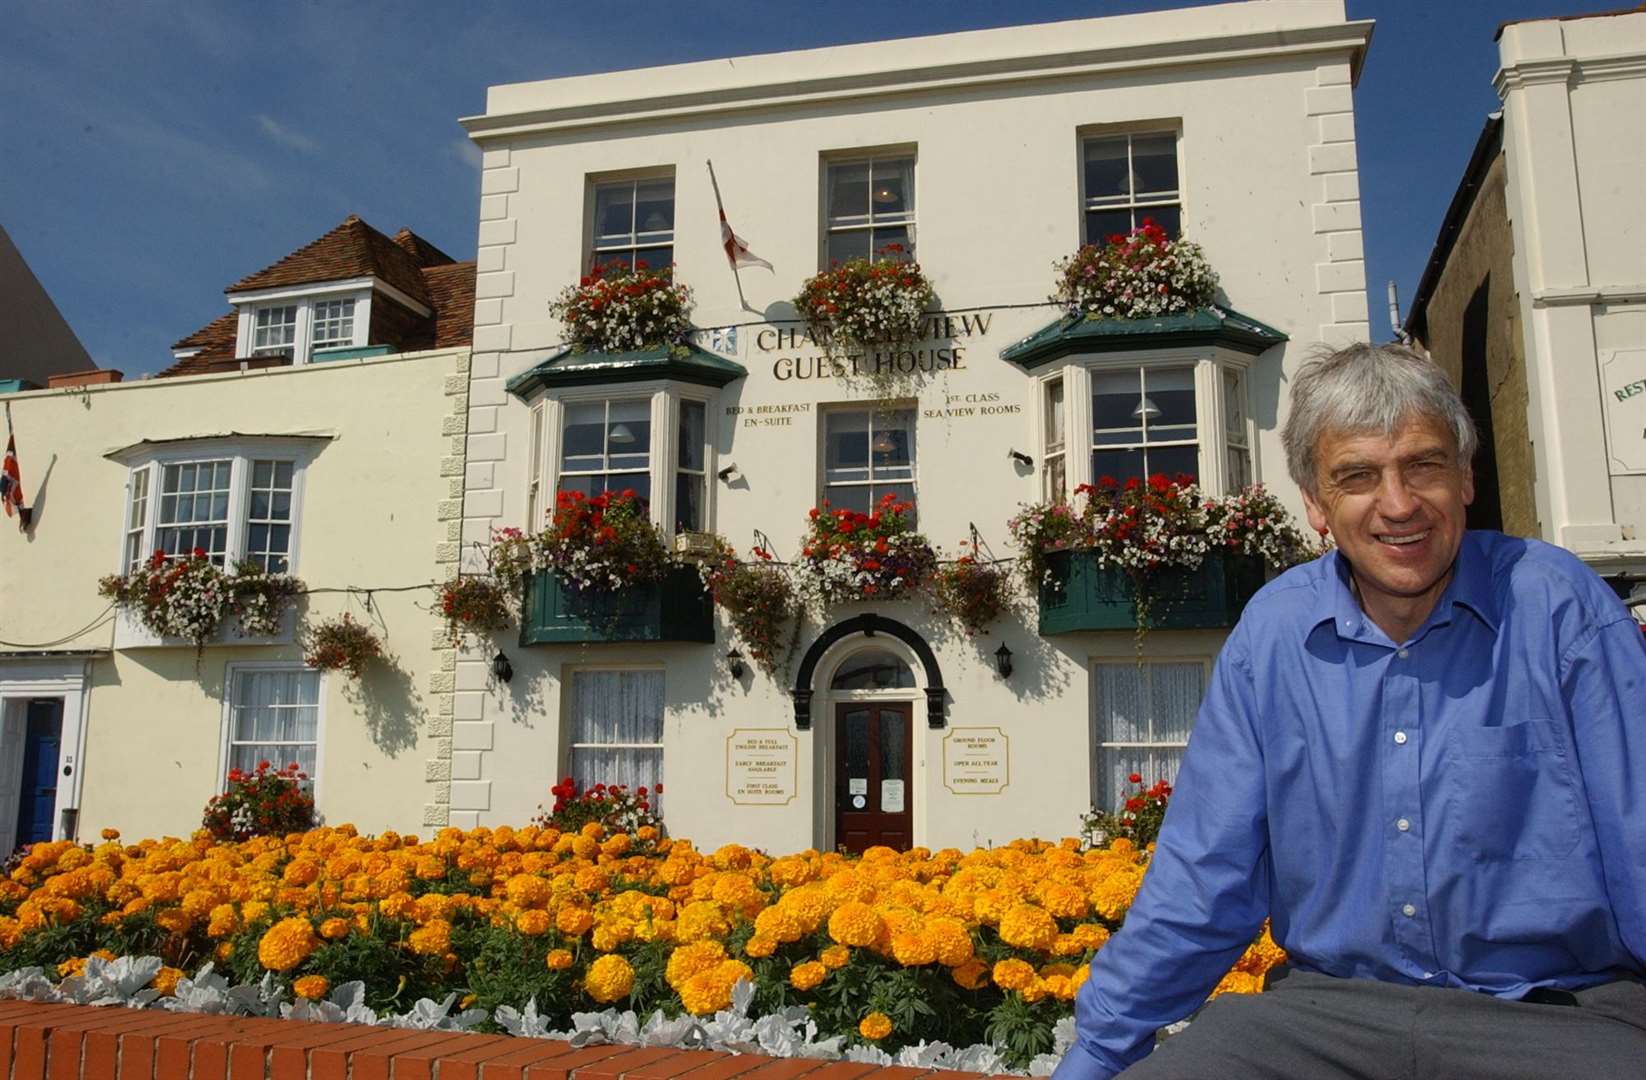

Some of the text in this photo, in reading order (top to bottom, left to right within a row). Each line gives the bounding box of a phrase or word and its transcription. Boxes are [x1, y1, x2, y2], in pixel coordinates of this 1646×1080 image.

[773, 347, 967, 381] GUEST HOUSE
[965, 392, 1000, 403] CLASS
[725, 403, 811, 416] BED & BREAKFAST
[923, 404, 1021, 418] SEA VIEW ROOMS
[744, 416, 793, 428] EN-SUITE
